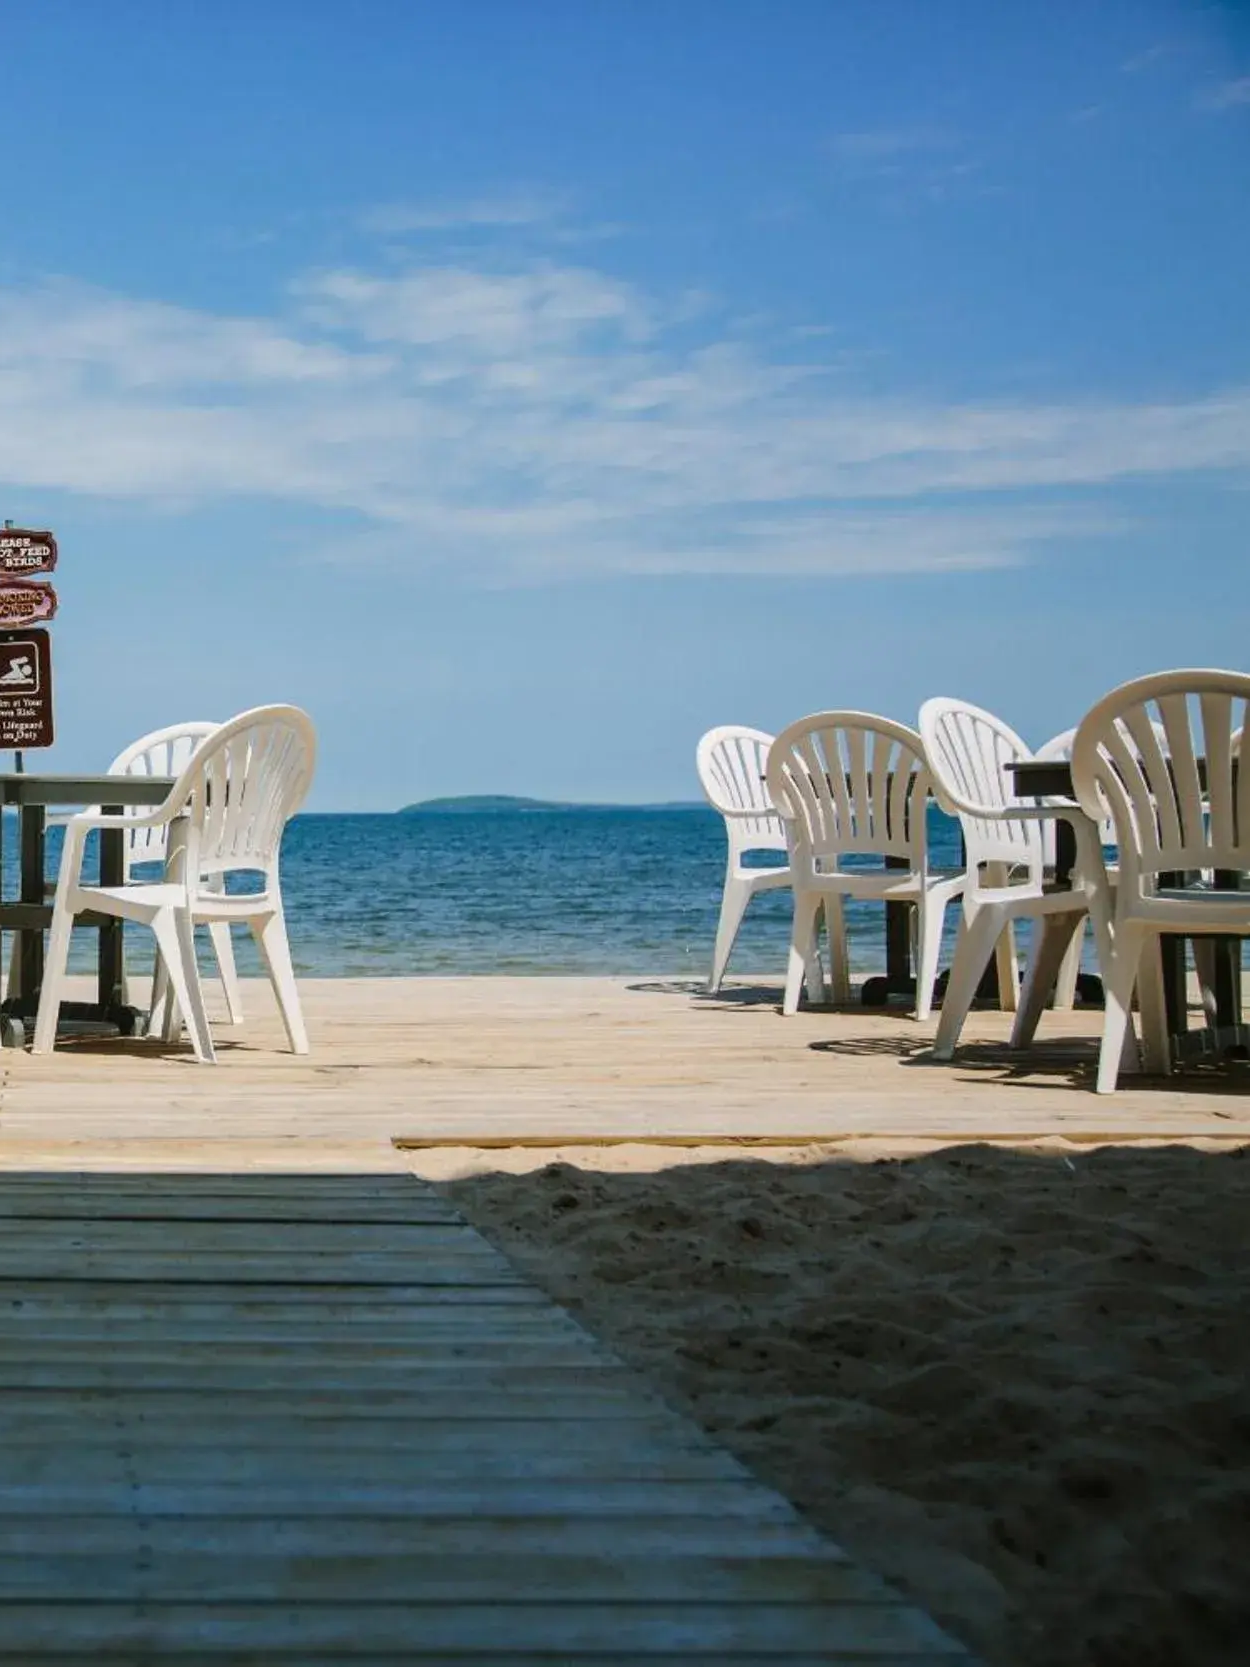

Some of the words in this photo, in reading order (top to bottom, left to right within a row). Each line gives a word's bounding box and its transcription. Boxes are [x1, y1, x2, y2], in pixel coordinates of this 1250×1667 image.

[20, 546, 50, 556] FEED
[6, 557, 42, 567] BIRDS
[3, 720, 43, 731] Lifeguard
